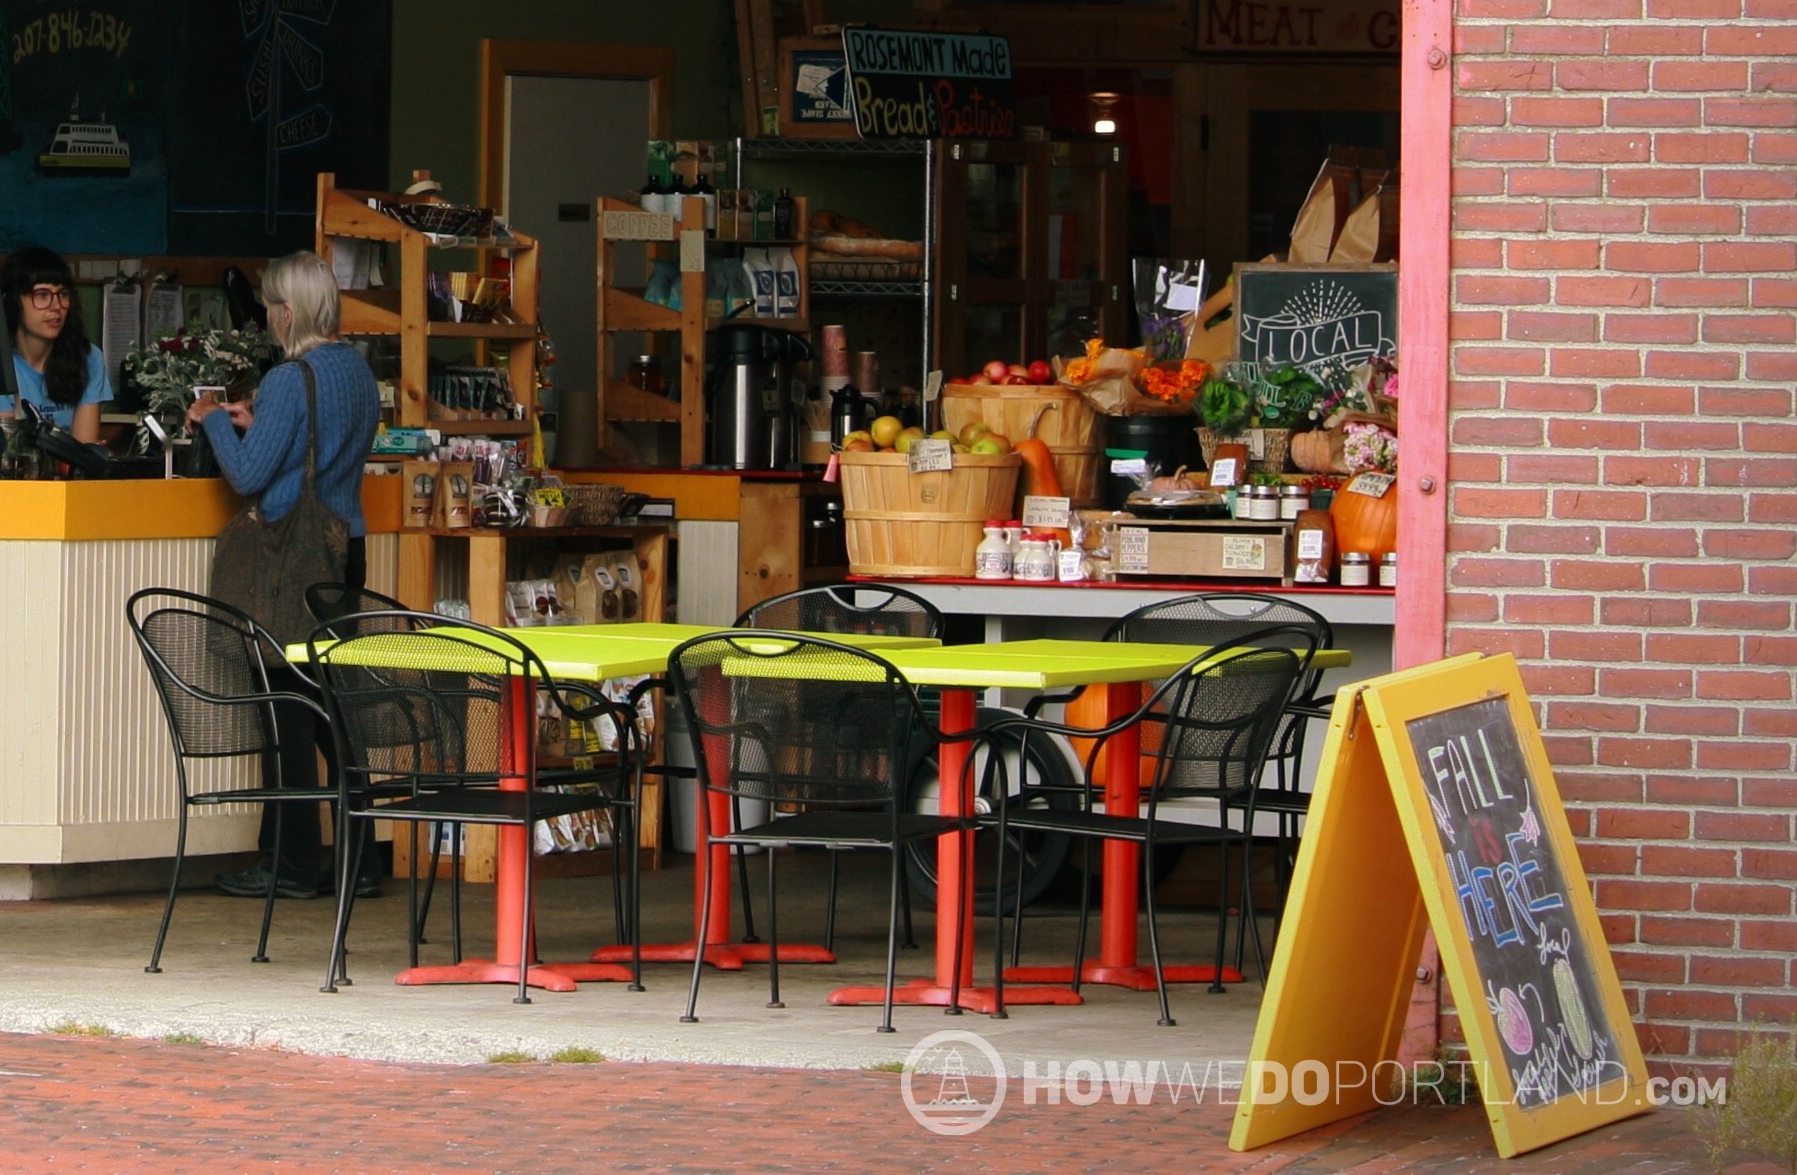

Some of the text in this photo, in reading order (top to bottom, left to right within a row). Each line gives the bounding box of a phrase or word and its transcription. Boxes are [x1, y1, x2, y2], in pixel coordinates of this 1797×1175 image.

[1368, 10, 1400, 48] C
[250, 40, 274, 104] SUSHI
[851, 31, 1006, 76] ROSEMONT Made
[279, 112, 320, 143] CHEESE
[853, 76, 928, 136] Bread
[606, 213, 672, 238] COFFEE
[1269, 317, 1372, 365] LOCAL
[1428, 728, 1512, 819] FALL
[1447, 832, 1563, 947] HERE
